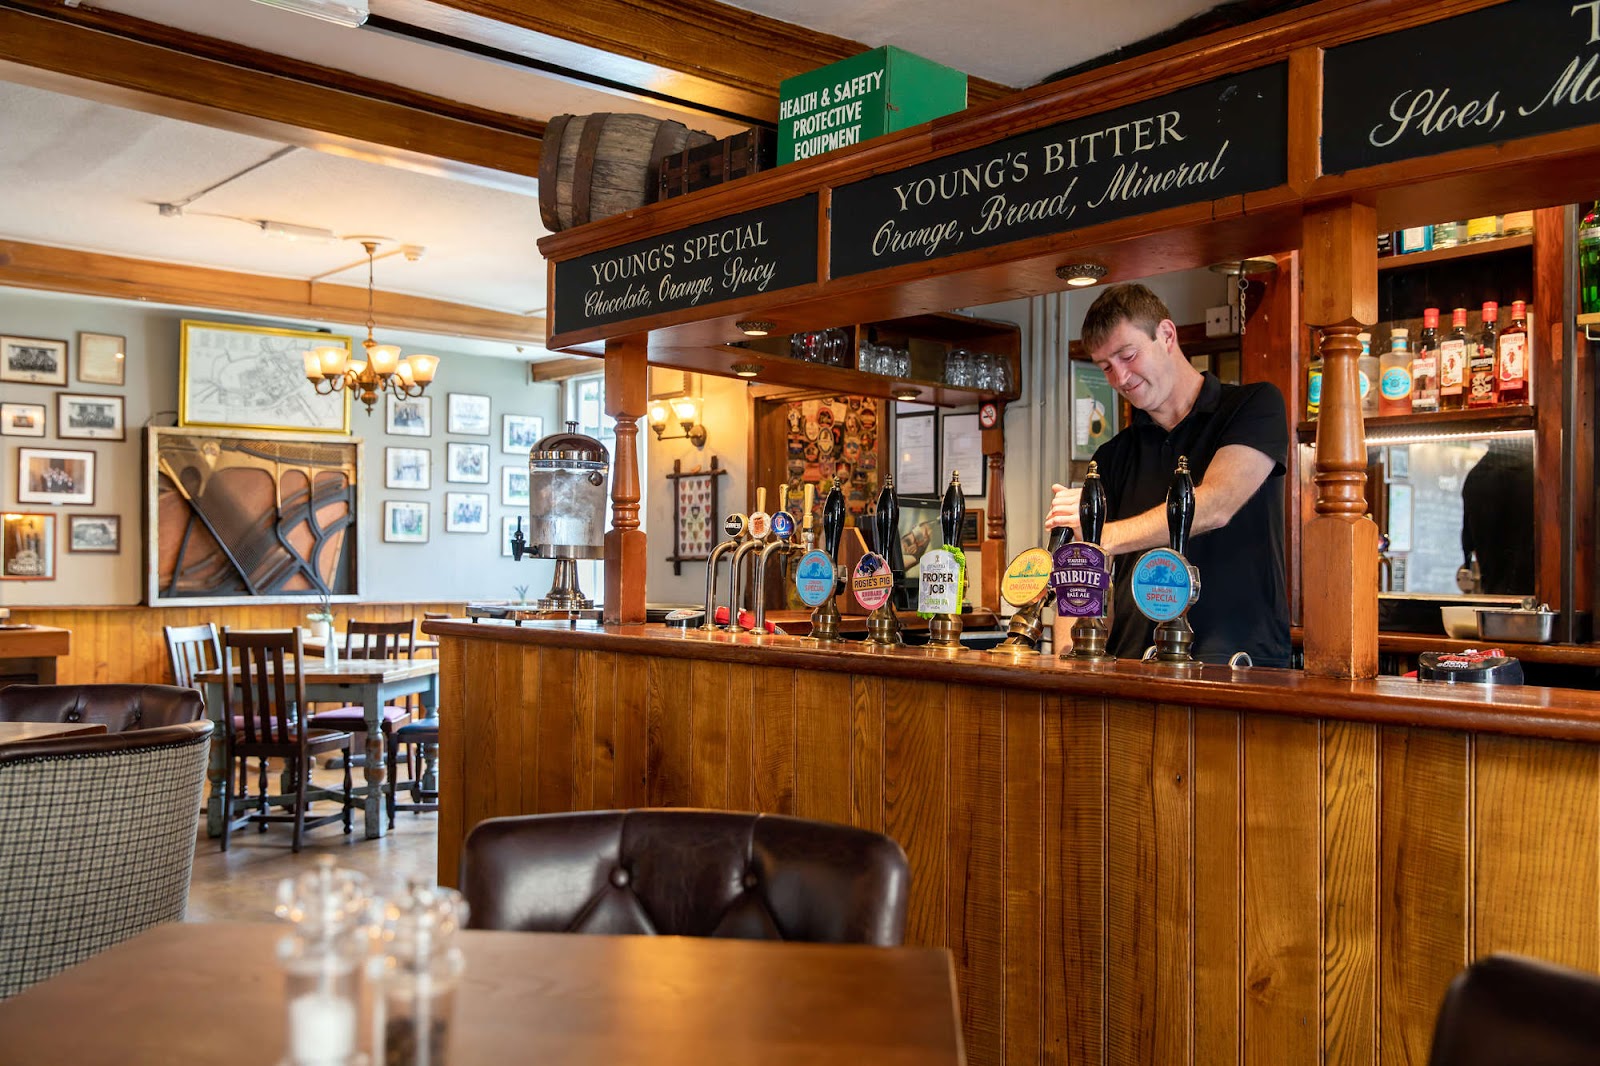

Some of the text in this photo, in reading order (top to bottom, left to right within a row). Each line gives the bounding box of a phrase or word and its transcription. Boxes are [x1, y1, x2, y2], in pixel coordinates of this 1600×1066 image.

[780, 69, 884, 121] HEALTH & SAFETY
[793, 101, 862, 139] PROTECTIVE
[1369, 88, 1506, 147] Sloes,
[794, 125, 862, 161] EQUIPMENT
[894, 110, 1187, 212] YOUNG'S BITTER
[872, 140, 1230, 258] Orange, Bread, Mineral
[591, 222, 769, 286] YOUNG'S SPECIAL
[584, 255, 776, 318] Chocolate, Orange, Spicy
[854, 575, 890, 589] ROSIE'S PIG
[922, 572, 954, 583] PROPER
[929, 584, 945, 596] JOB
[1009, 583, 1039, 591] ORIGINAL
[1053, 570, 1101, 586] TRIBUTE
[1146, 593, 1177, 603] SPECIAL
